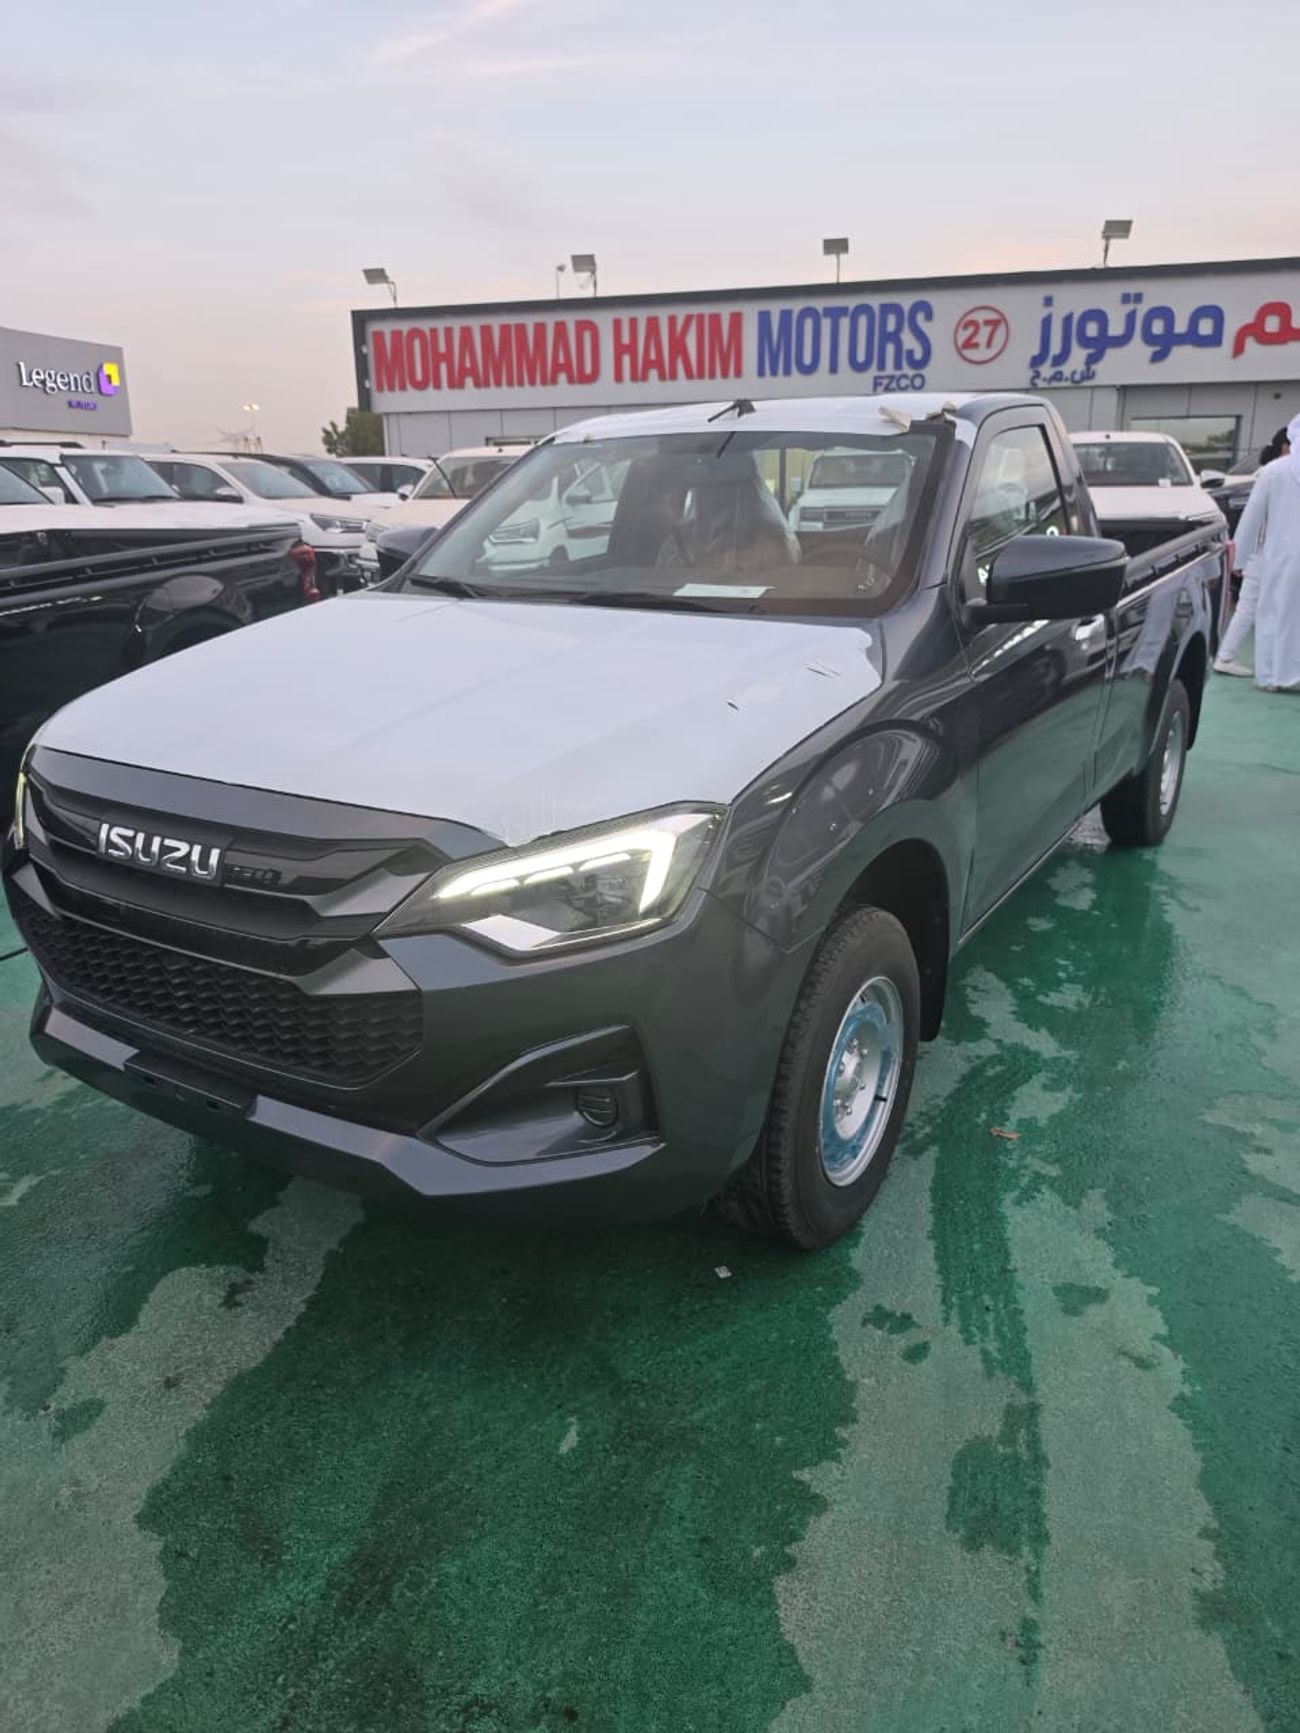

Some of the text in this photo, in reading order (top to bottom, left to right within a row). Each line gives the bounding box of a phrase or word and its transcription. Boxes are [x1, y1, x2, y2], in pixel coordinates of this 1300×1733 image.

[371, 300, 934, 393] MOHAMMAD HAKIM MOTORS
[960, 318, 1002, 350] 27
[1029, 292, 1225, 368] موتورز
[17, 361, 95, 395] Legend
[872, 373, 926, 393] FZCO
[99, 823, 221, 881] ISUZU
